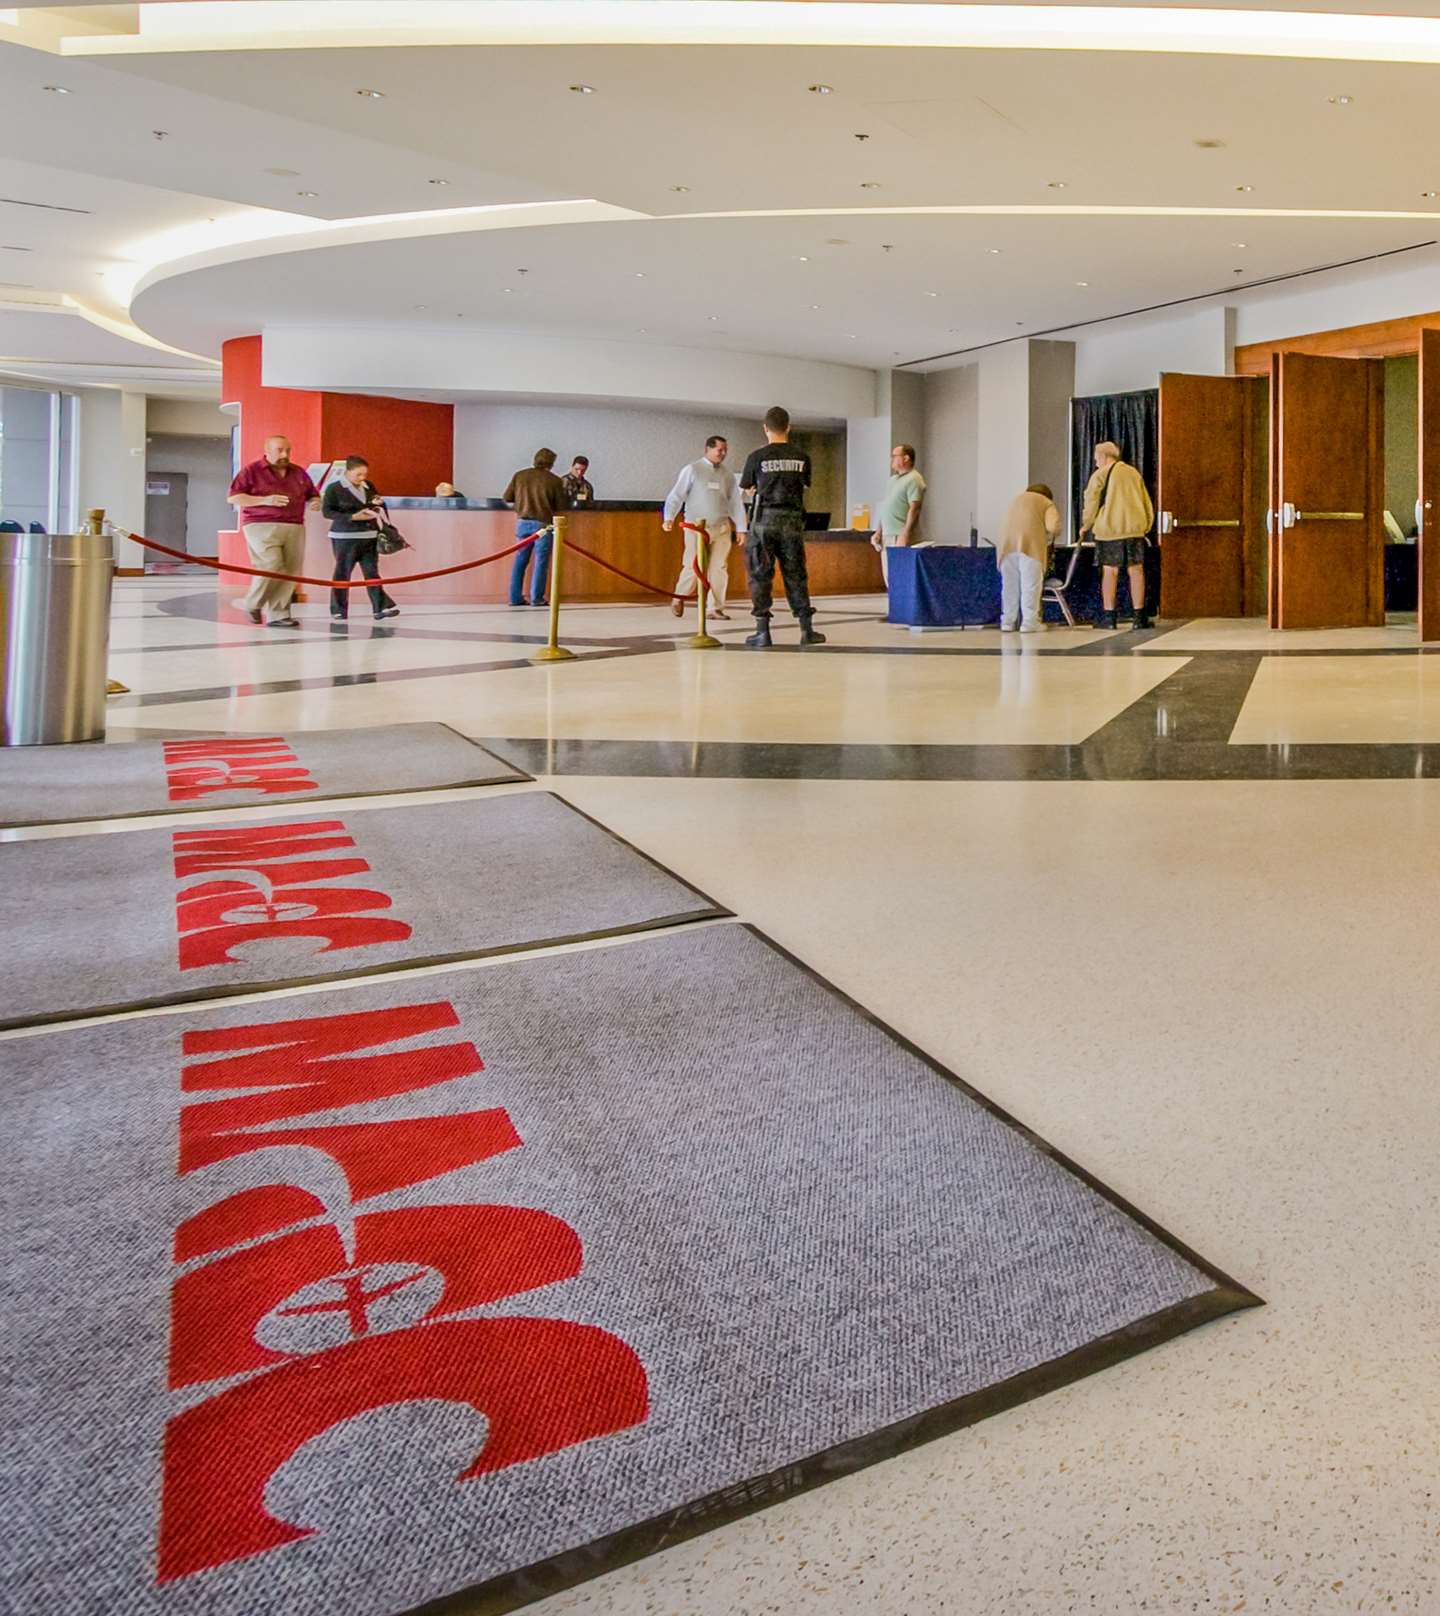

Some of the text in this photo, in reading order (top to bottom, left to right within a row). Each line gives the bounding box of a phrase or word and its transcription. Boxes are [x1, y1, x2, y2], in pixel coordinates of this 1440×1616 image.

[761, 459, 805, 473] SECURITY
[172, 820, 412, 971] MACC
[156, 1001, 649, 1584] MACC
